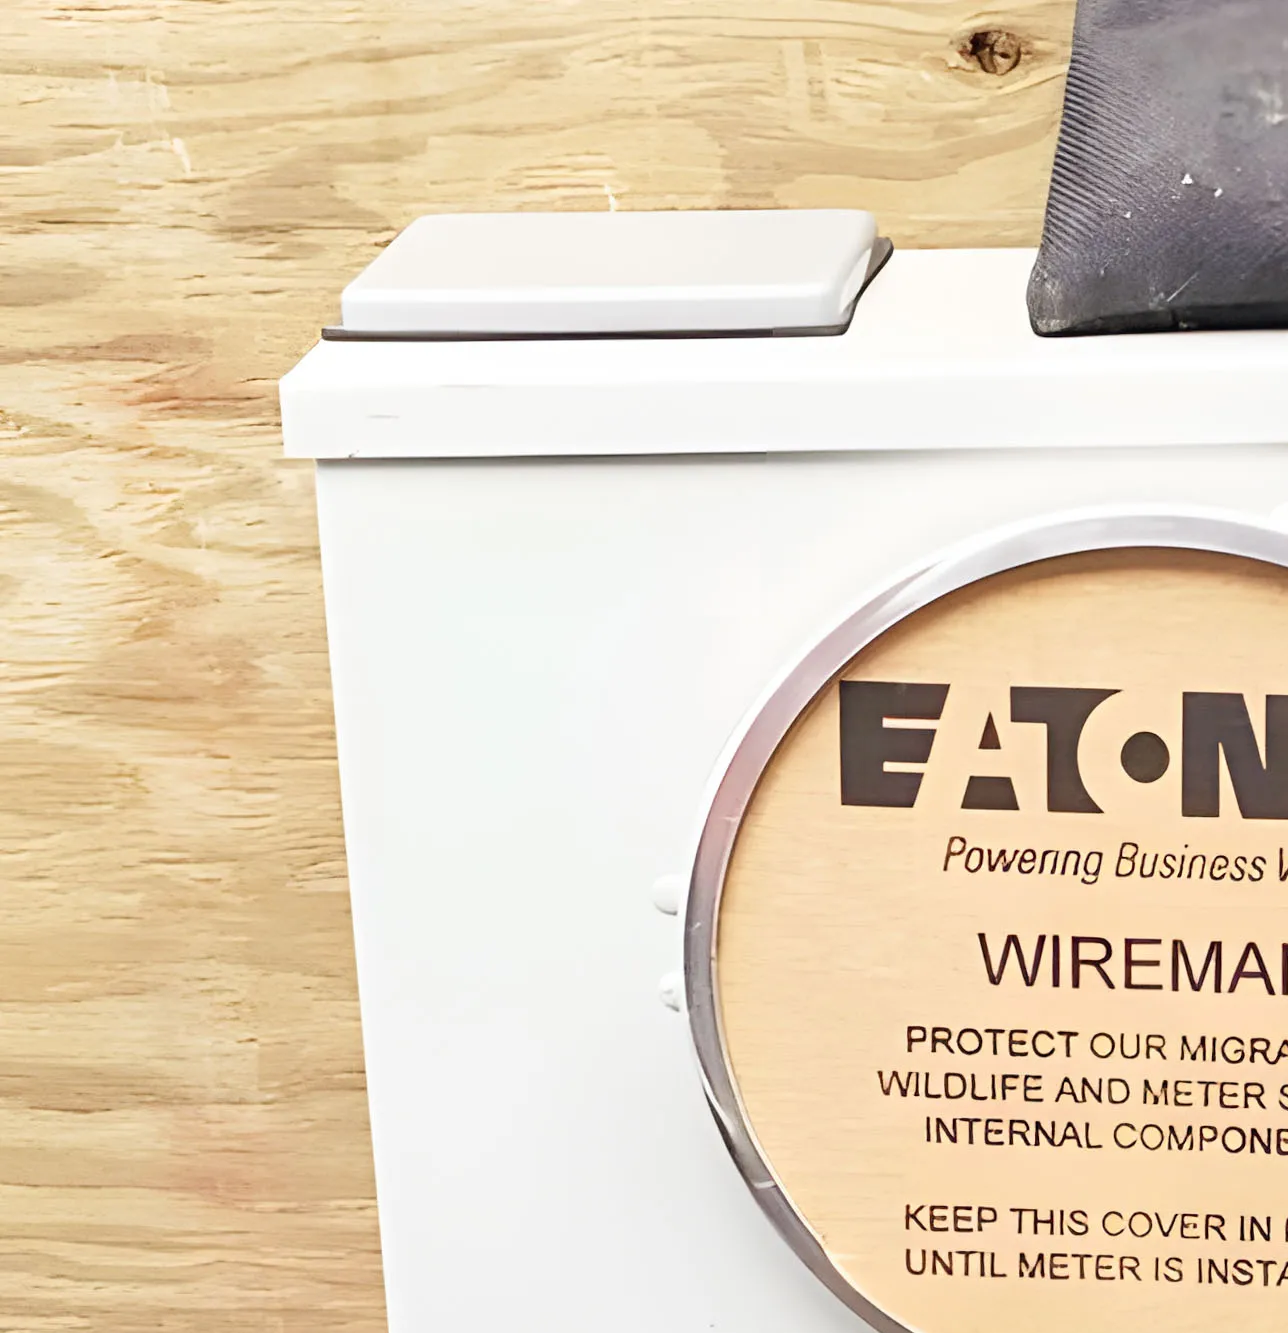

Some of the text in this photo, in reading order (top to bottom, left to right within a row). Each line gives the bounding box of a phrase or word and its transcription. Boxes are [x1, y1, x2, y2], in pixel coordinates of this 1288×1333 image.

[942, 835, 1101, 885] Powering
[1115, 841, 1266, 882] Business
[906, 1025, 1080, 1061] PROTECT
[1088, 1032, 1168, 1062] OUR
[877, 1070, 1044, 1103] WILDLIFE
[1054, 1076, 1131, 1105] AND
[1142, 1079, 1267, 1110] METER
[925, 1116, 1103, 1149] INTERNAL
[904, 1204, 998, 1236] KEEP
[1009, 1207, 1090, 1237] THIS
[1101, 1210, 1227, 1242] COVER
[1239, 1214, 1272, 1242] IN
[905, 1248, 1007, 1278] UNTIL
[1018, 1251, 1143, 1282] METER
[1154, 1256, 1184, 1284] IS
